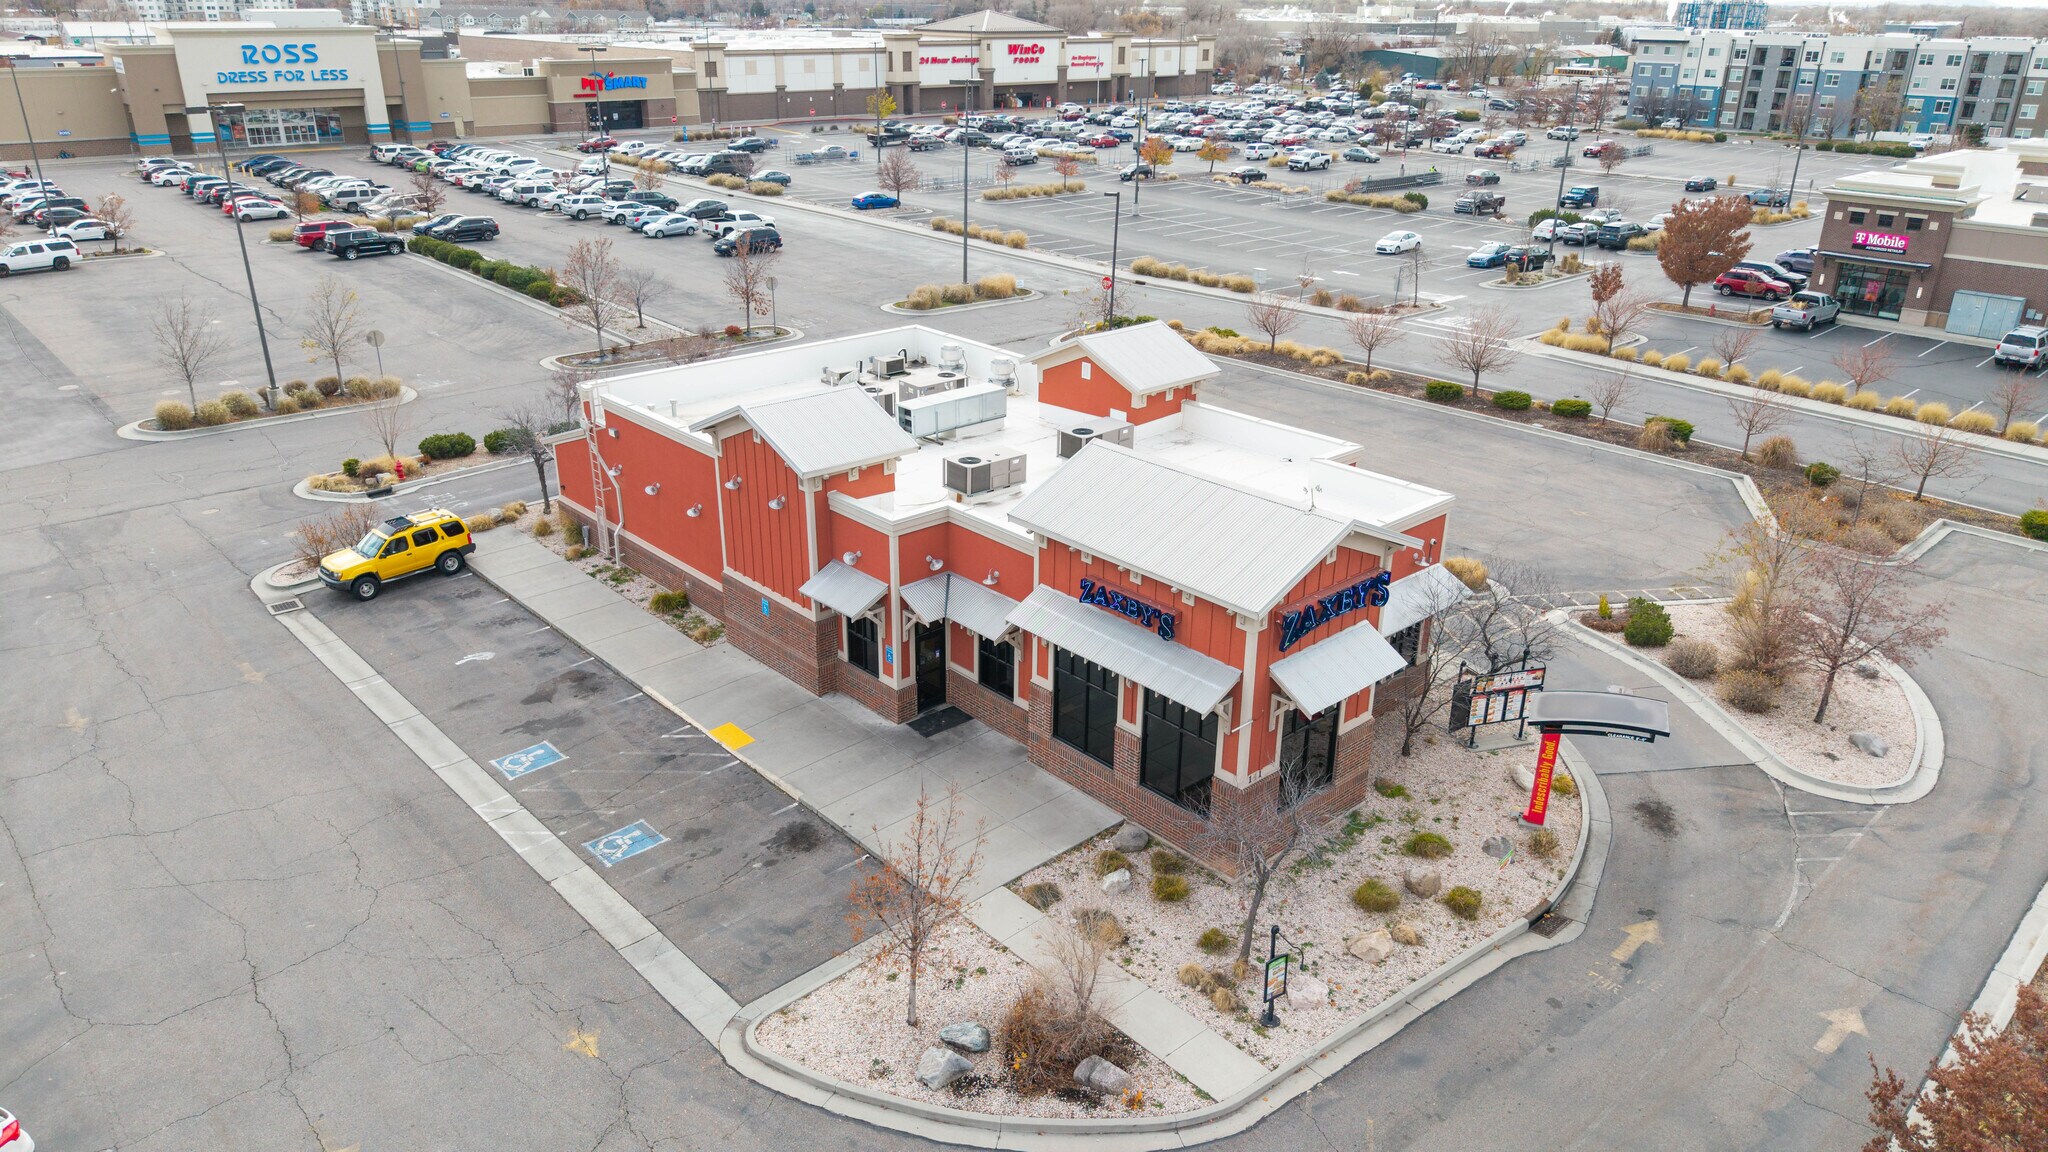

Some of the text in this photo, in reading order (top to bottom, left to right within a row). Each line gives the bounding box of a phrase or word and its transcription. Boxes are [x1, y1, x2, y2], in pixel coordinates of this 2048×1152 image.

[241, 43, 319, 64] ROSS
[1008, 43, 1045, 55] WinCo
[919, 55, 980, 65] 24 Hour Savings
[217, 69, 349, 84] DRESS FOR LESS
[1867, 233, 1906, 248] Mobile
[1079, 578, 1175, 641] ZAXBY'S
[1279, 570, 1392, 652] ZAXBY'S
[1532, 740, 1557, 813] Indescribably Good.
